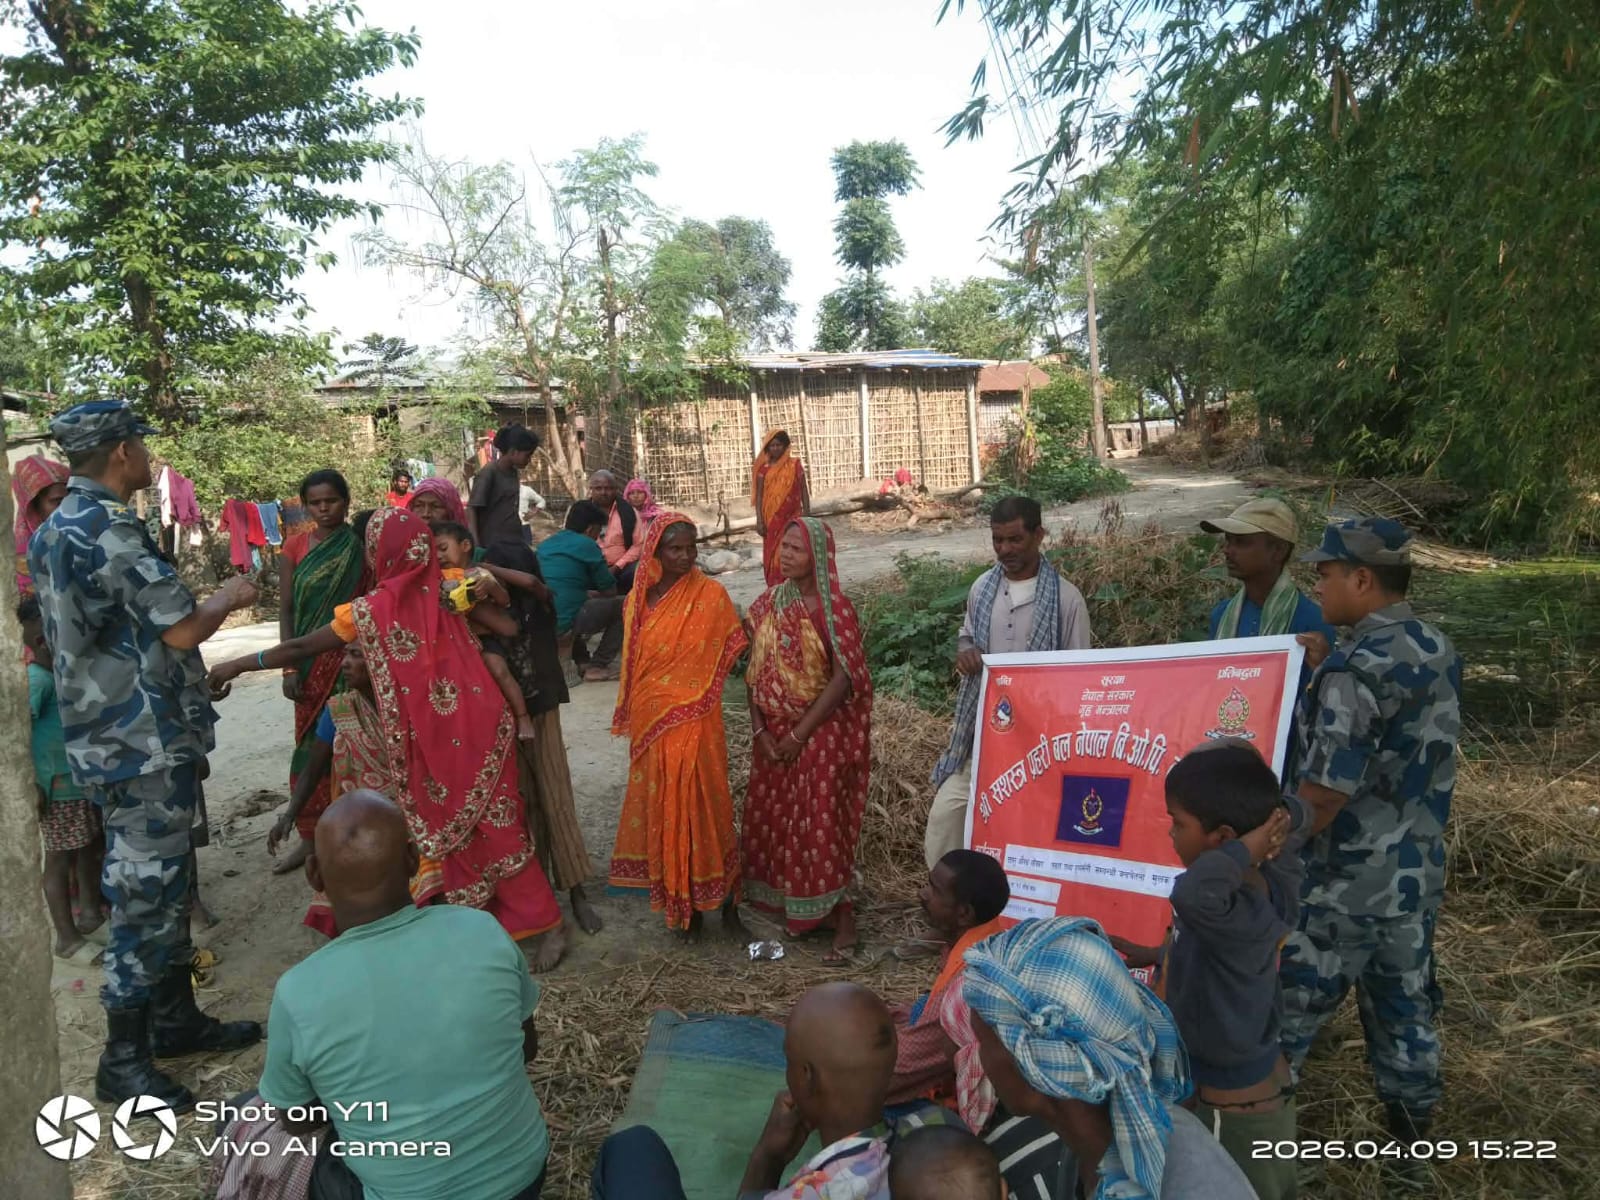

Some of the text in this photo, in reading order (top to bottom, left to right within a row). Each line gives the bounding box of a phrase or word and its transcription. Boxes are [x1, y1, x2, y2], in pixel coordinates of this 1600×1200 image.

[1081, 688, 1136, 701] नेपाल सरकार
[1075, 721, 1113, 759] नेपाल
